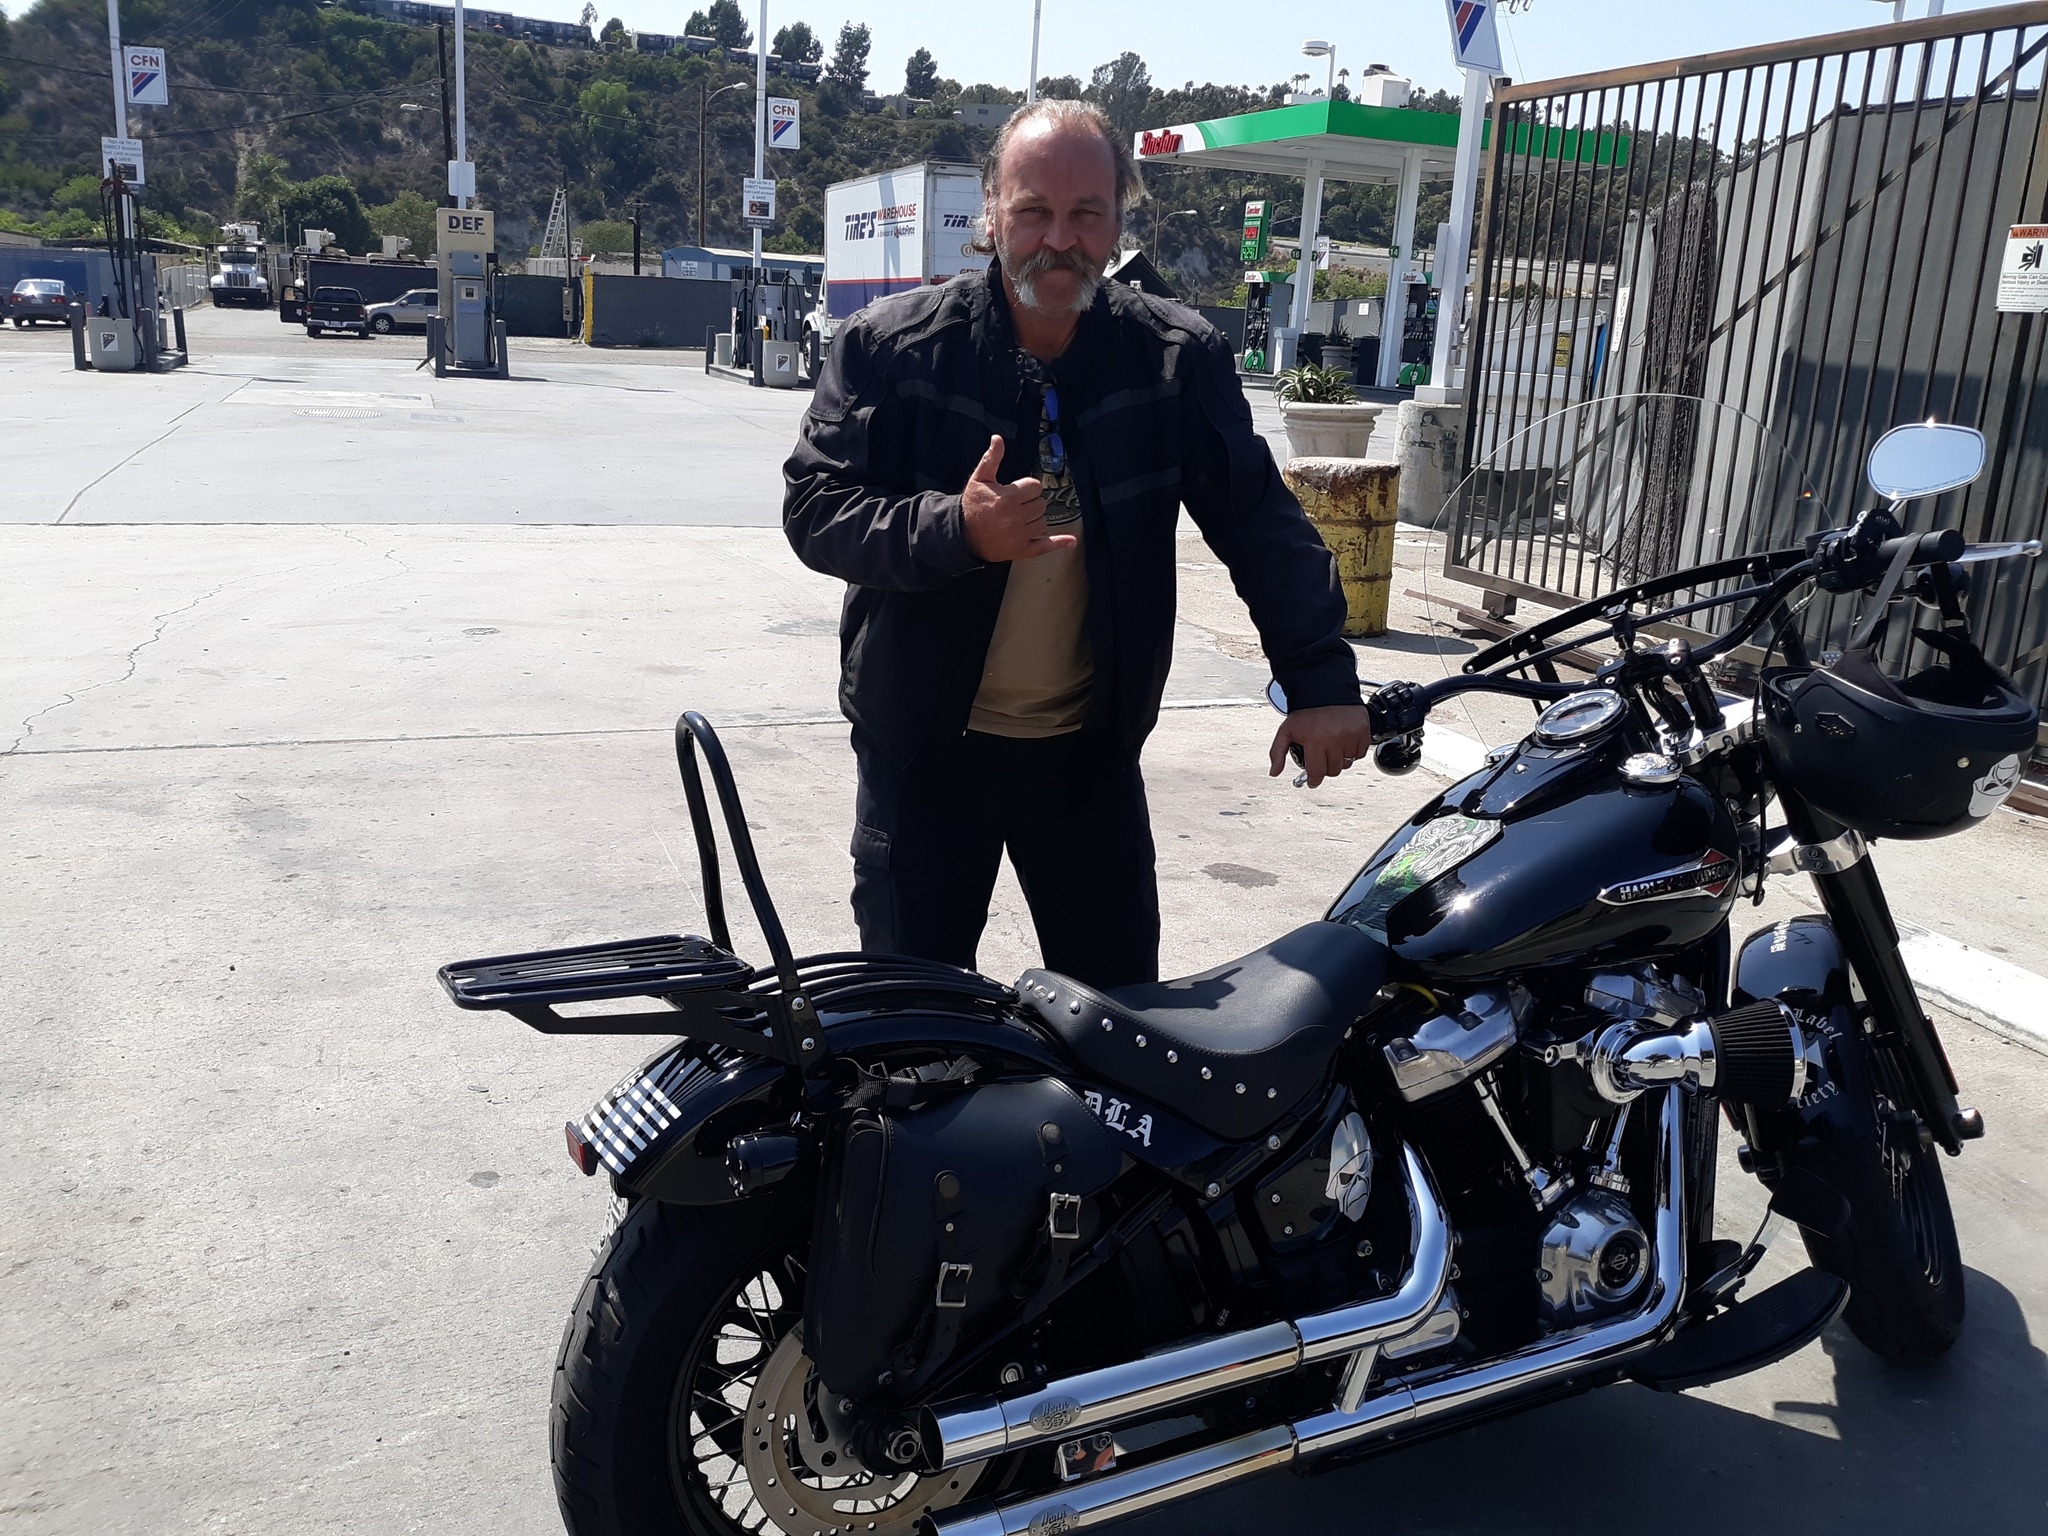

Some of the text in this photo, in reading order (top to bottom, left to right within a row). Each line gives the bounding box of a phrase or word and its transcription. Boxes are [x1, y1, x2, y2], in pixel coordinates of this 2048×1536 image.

[131, 54, 160, 67] CFN
[773, 105, 795, 116] CFN
[878, 203, 917, 221] WAREHOUSE
[448, 215, 484, 230] DEF
[1292, 250, 1300, 259] 16
[1390, 248, 1398, 256] 14
[1791, 1007, 1844, 1042] Label
